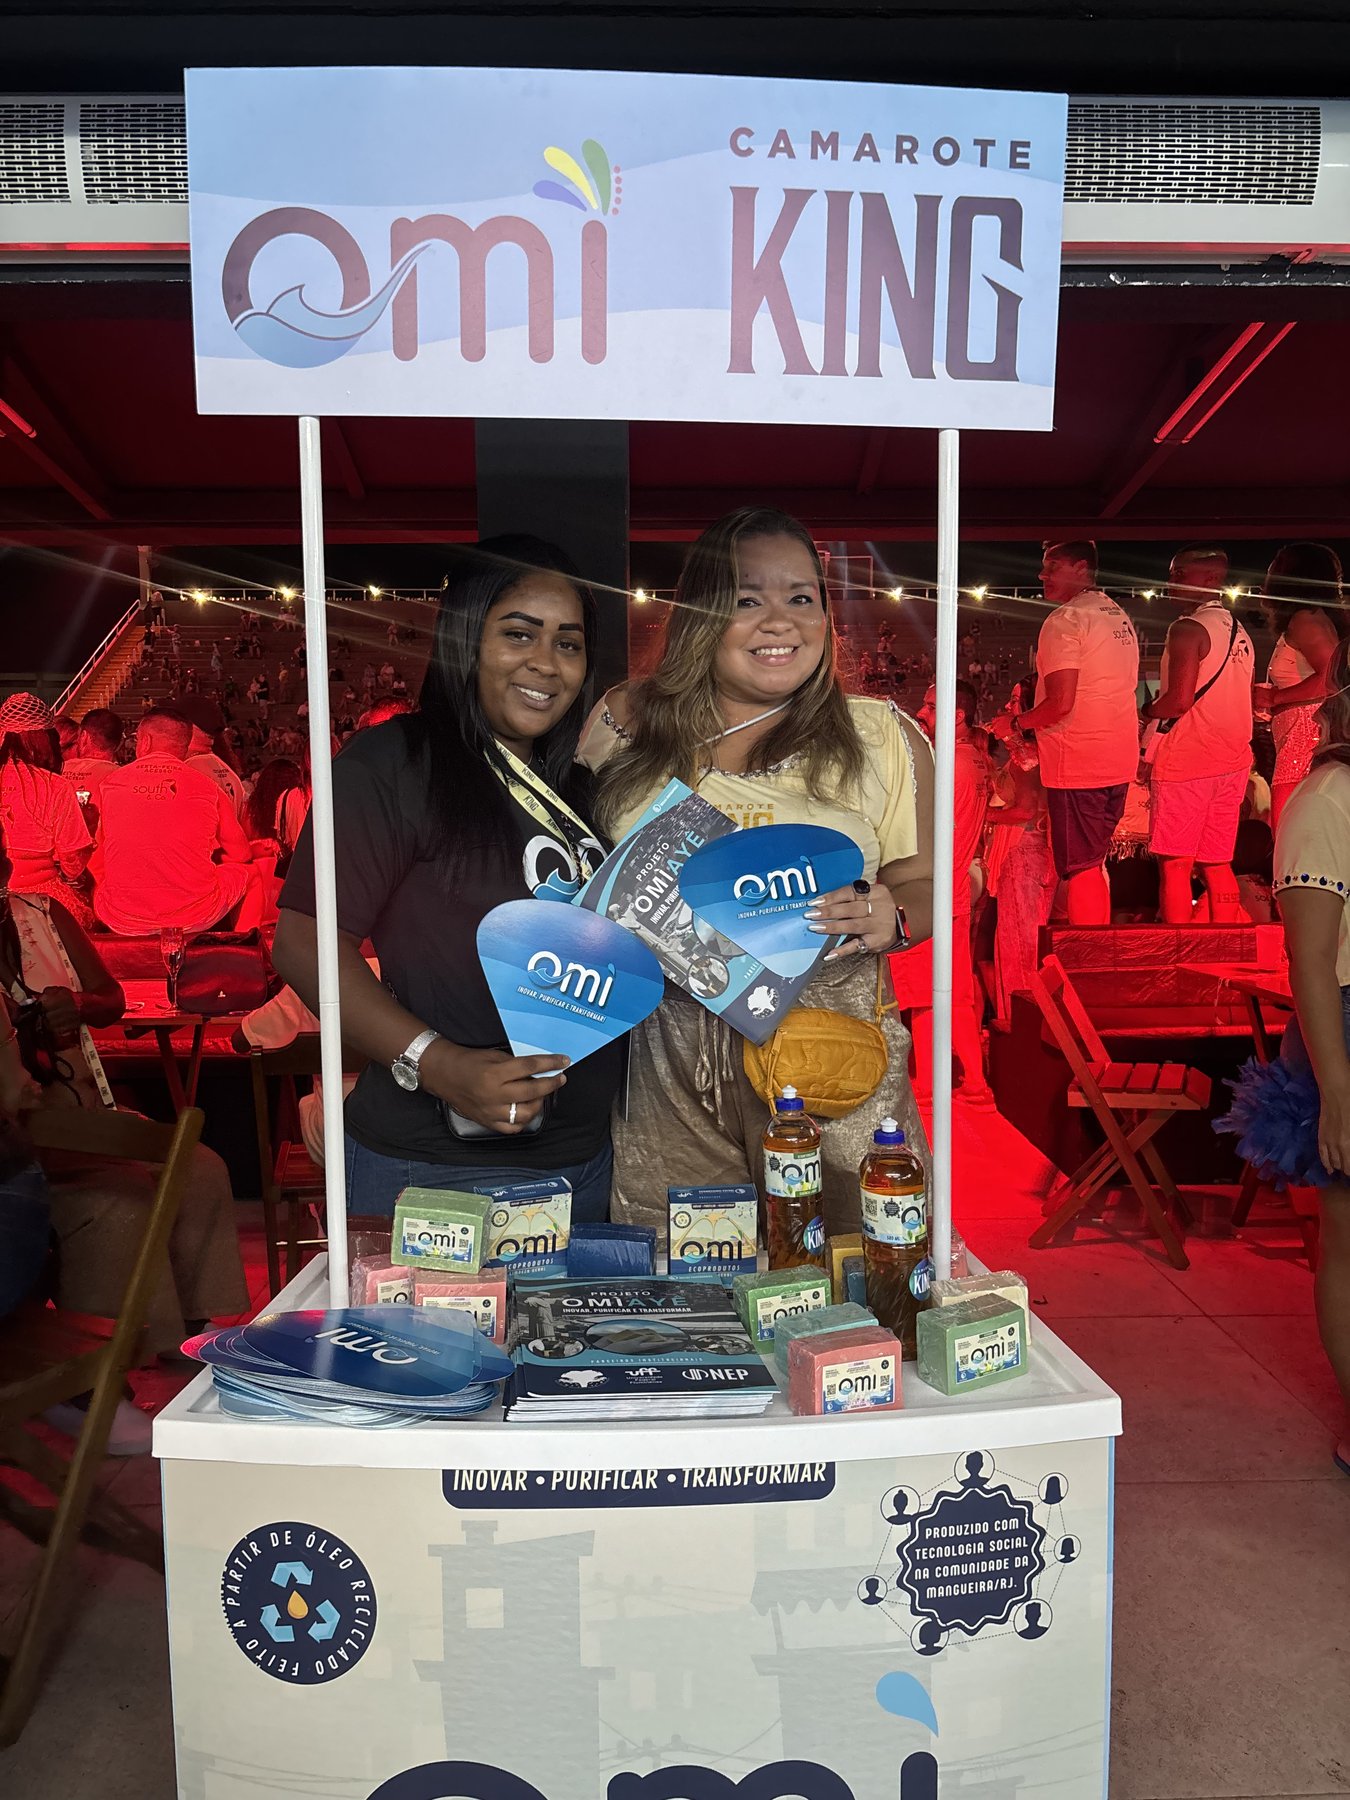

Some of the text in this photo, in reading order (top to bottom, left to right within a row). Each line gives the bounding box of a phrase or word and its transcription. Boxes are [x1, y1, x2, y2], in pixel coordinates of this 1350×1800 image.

[729, 127, 1031, 169] CAMAROTE
[727, 186, 1024, 382] KING
[522, 795, 540, 811] KING
[636, 842, 670, 882] PROJETO
[538, 993, 566, 1009] PURIFICAR
[688, 1264, 741, 1273] ECOPRODUTOS
[709, 1369, 749, 1380] NEP
[453, 1462, 827, 1491] INOVAR PURIFICAR TRANSFORMAR
[925, 1518, 1019, 1539] PRODUZIDO COM
[915, 1536, 1028, 1560] TECNOLOGIA SOCIAL
[914, 1555, 1029, 1580] NA COMUNIDADE DA
[926, 1577, 1017, 1599] MANGUEIRA/RJ.
[226, 1530, 371, 1676] FEITO A PARTIR DE ÓLEO RECICLADO
